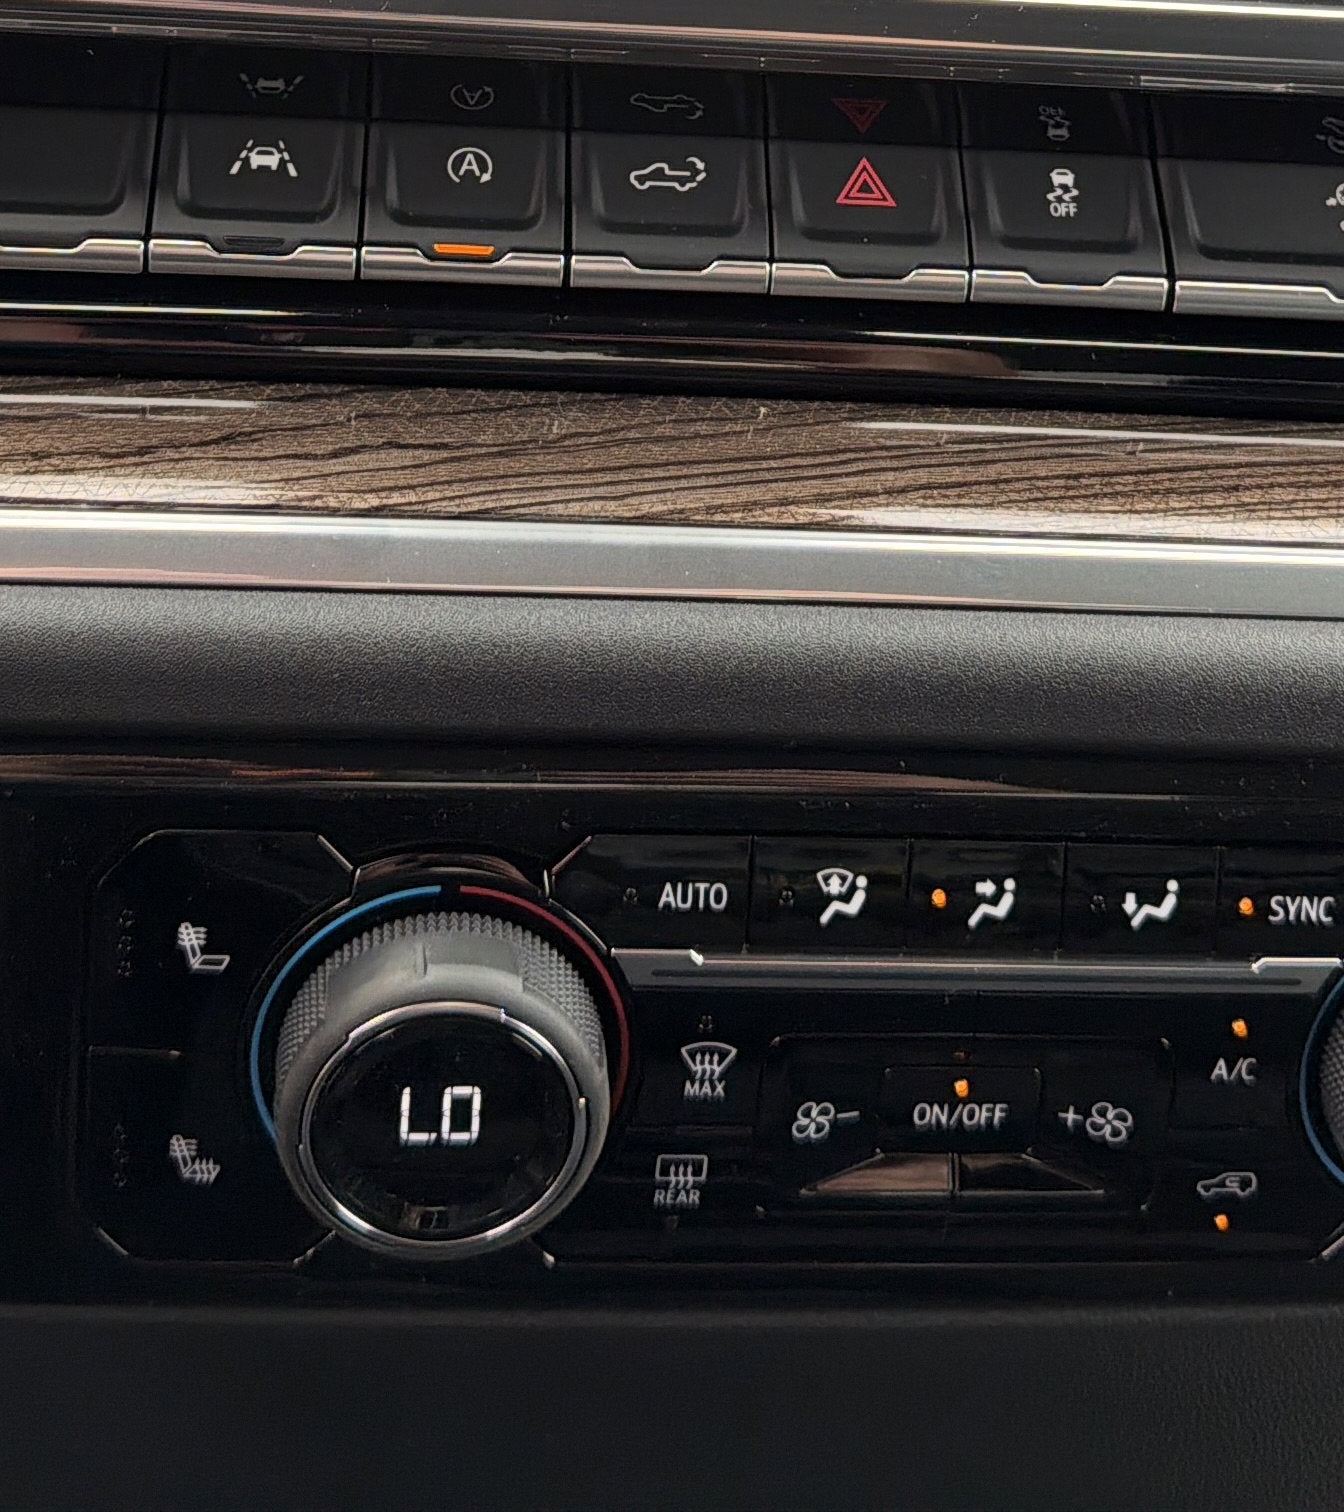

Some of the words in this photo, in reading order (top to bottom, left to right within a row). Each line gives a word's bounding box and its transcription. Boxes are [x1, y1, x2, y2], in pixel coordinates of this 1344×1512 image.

[1049, 202, 1078, 217] OFF
[658, 882, 728, 912] AUTO
[1268, 894, 1336, 924] SYNC
[1210, 1057, 1257, 1082] A/C
[683, 1079, 726, 1099] MAX
[398, 1084, 482, 1146] LO
[912, 1102, 1009, 1129] ON/OFF
[654, 1188, 700, 1207] REAR
